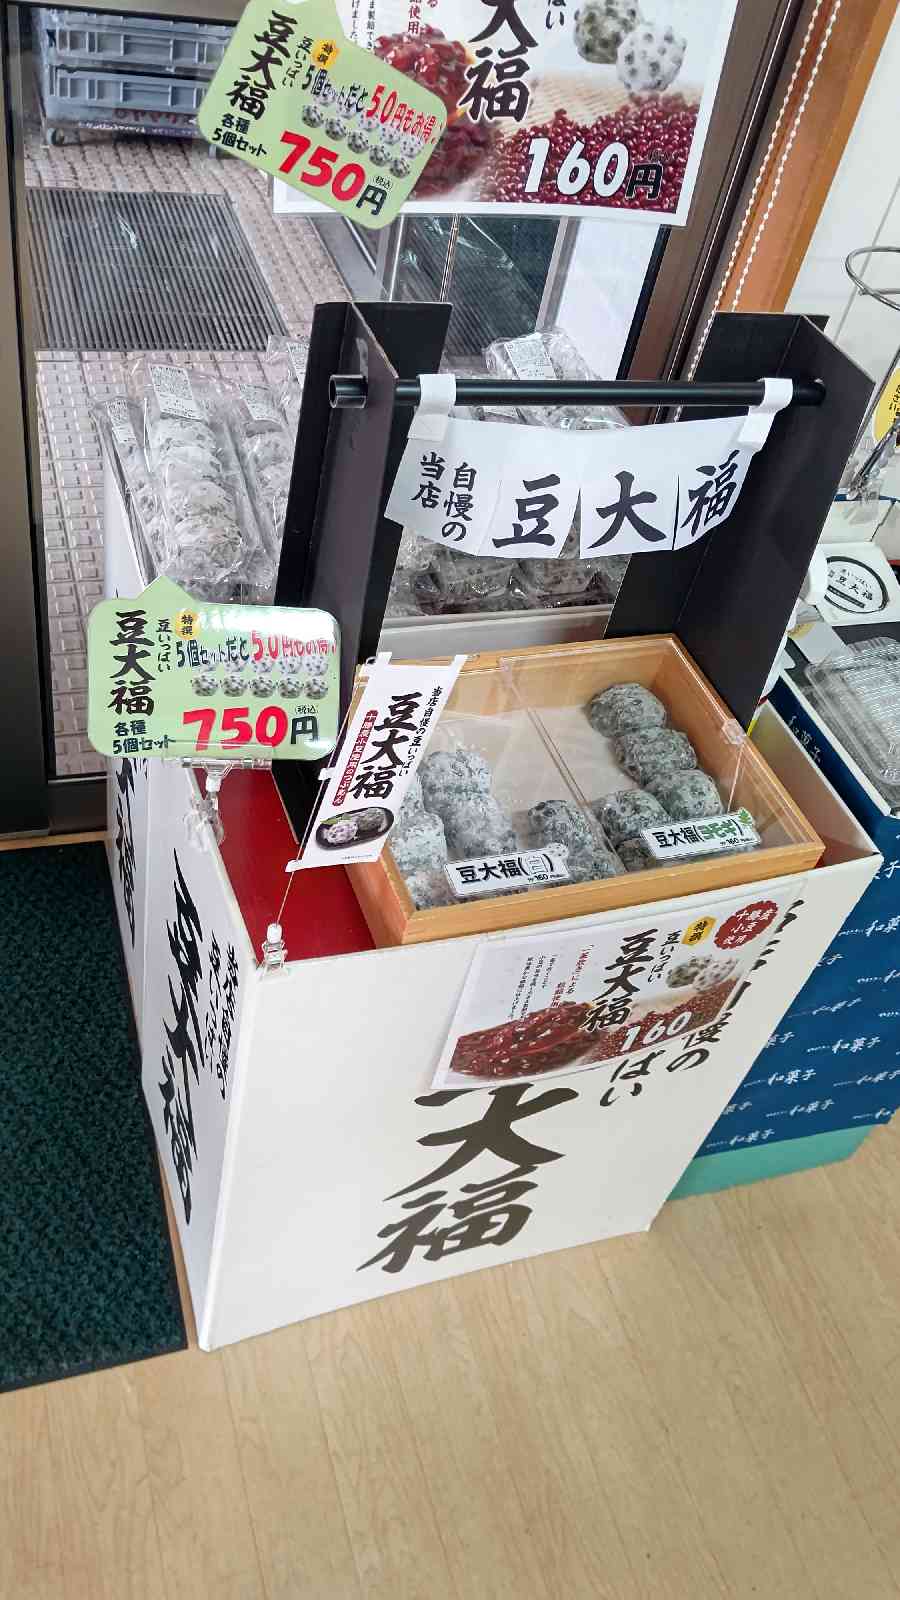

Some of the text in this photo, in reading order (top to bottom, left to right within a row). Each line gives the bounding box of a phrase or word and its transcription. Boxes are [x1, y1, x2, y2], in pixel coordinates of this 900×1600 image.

[226, 10, 298, 121] 豆大福
[212, 128, 268, 157] 5個セット
[221, 113, 250, 135] 各種
[411, 451, 446, 510] 当店
[441, 462, 477, 542] 自慢の
[156, 618, 172, 673] 豆いっぱい
[181, 614, 195, 636] 特撰
[107, 609, 156, 716] 豆大福
[112, 735, 177, 754] 5個セット
[113, 719, 146, 737] 各種
[349, 691, 423, 800] 豆大福
[579, 927, 659, 1033] 豆大福
[832, 1036, 880, 1054] 和菓子
[767, 1069, 816, 1086] 和菓子
[356, 1083, 578, 1274] 大福
